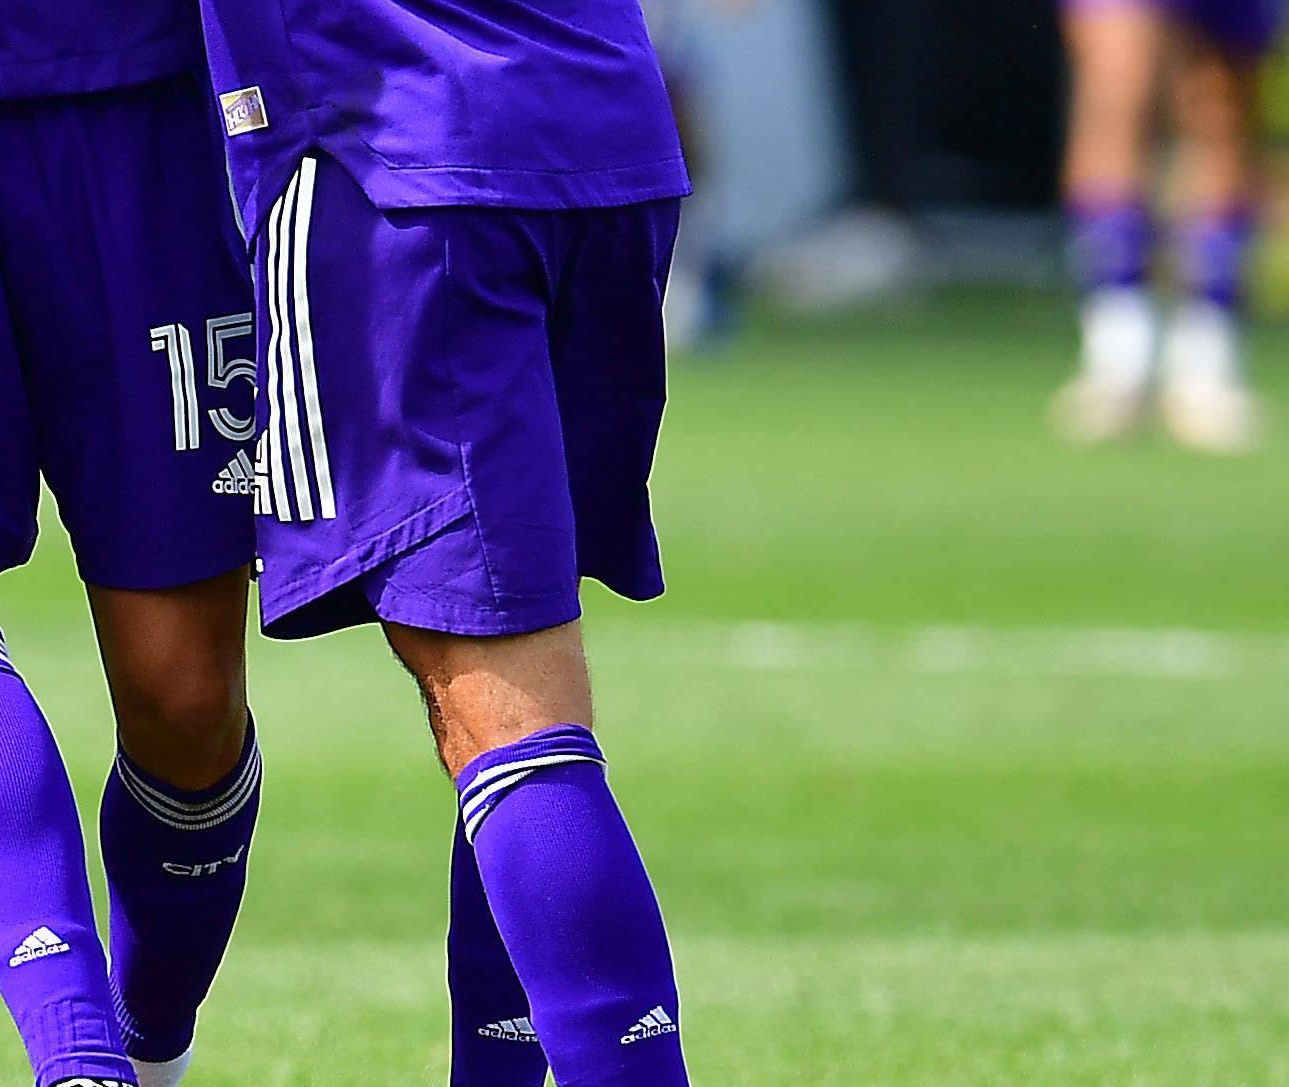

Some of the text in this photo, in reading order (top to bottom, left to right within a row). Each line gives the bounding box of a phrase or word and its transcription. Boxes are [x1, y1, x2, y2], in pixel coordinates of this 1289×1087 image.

[149, 312, 257, 451] 15
[162, 844, 245, 877] CITY
[9, 942, 71, 968] adidas
[620, 1023, 677, 1045] adidas
